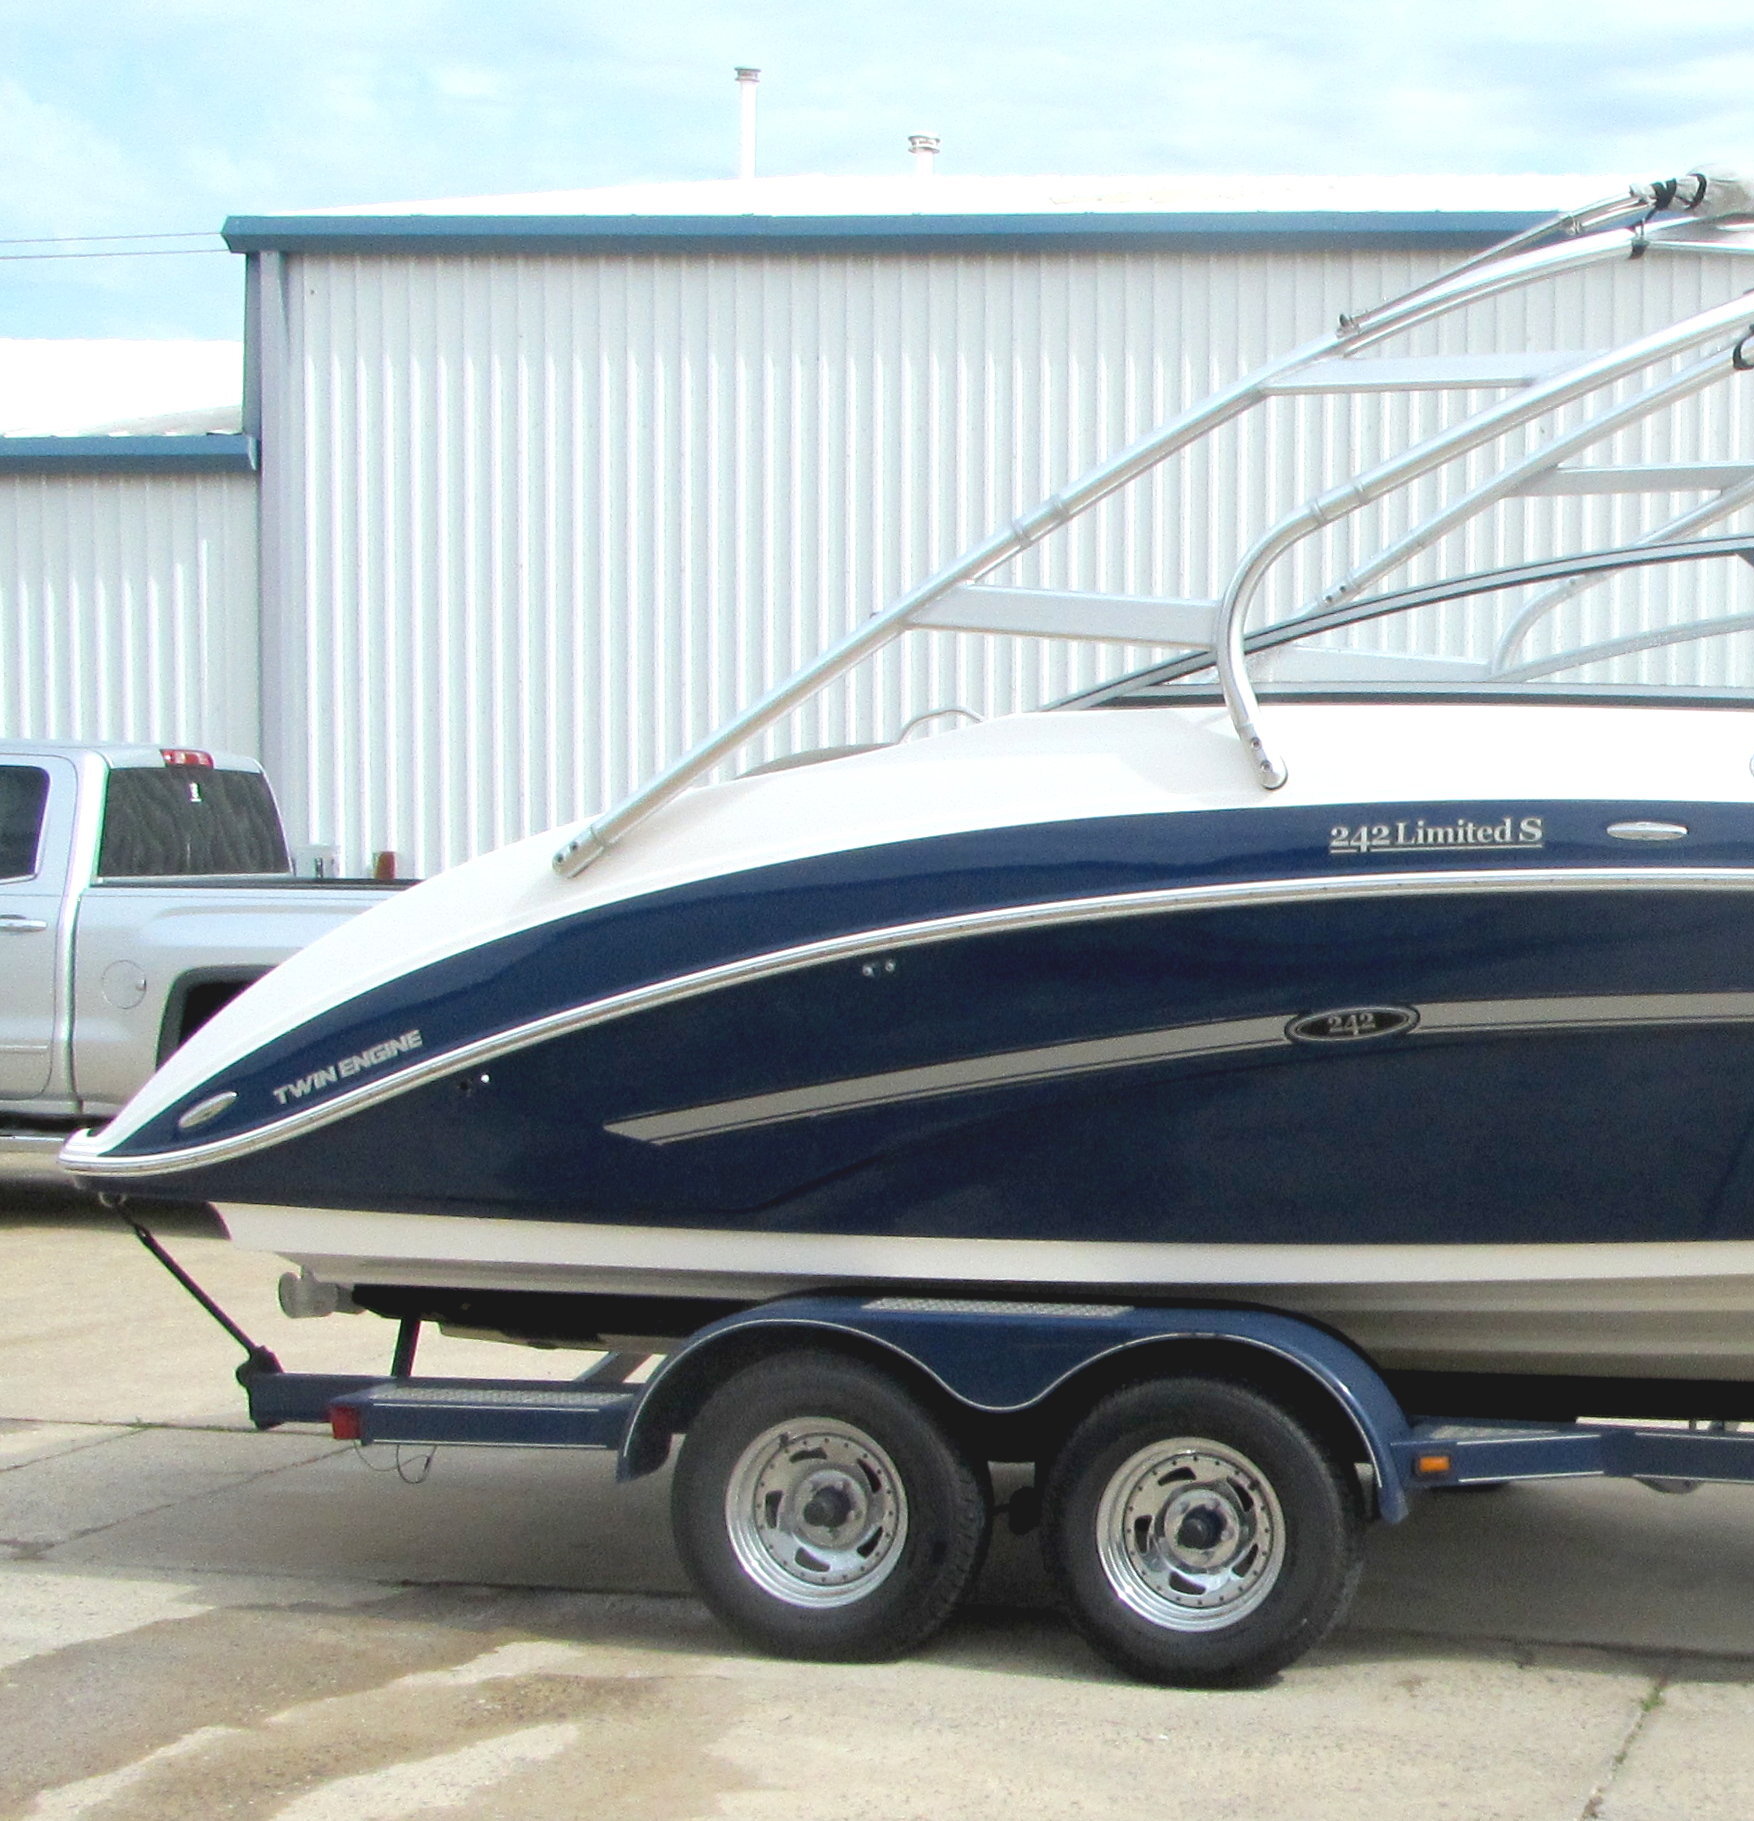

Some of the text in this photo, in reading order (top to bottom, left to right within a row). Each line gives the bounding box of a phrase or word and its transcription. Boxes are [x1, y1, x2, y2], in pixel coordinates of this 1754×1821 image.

[1330, 817, 1543, 854] 242 Limited S
[1327, 1012, 1377, 1036] 242
[273, 1029, 423, 1105] TWIN ENGINE
